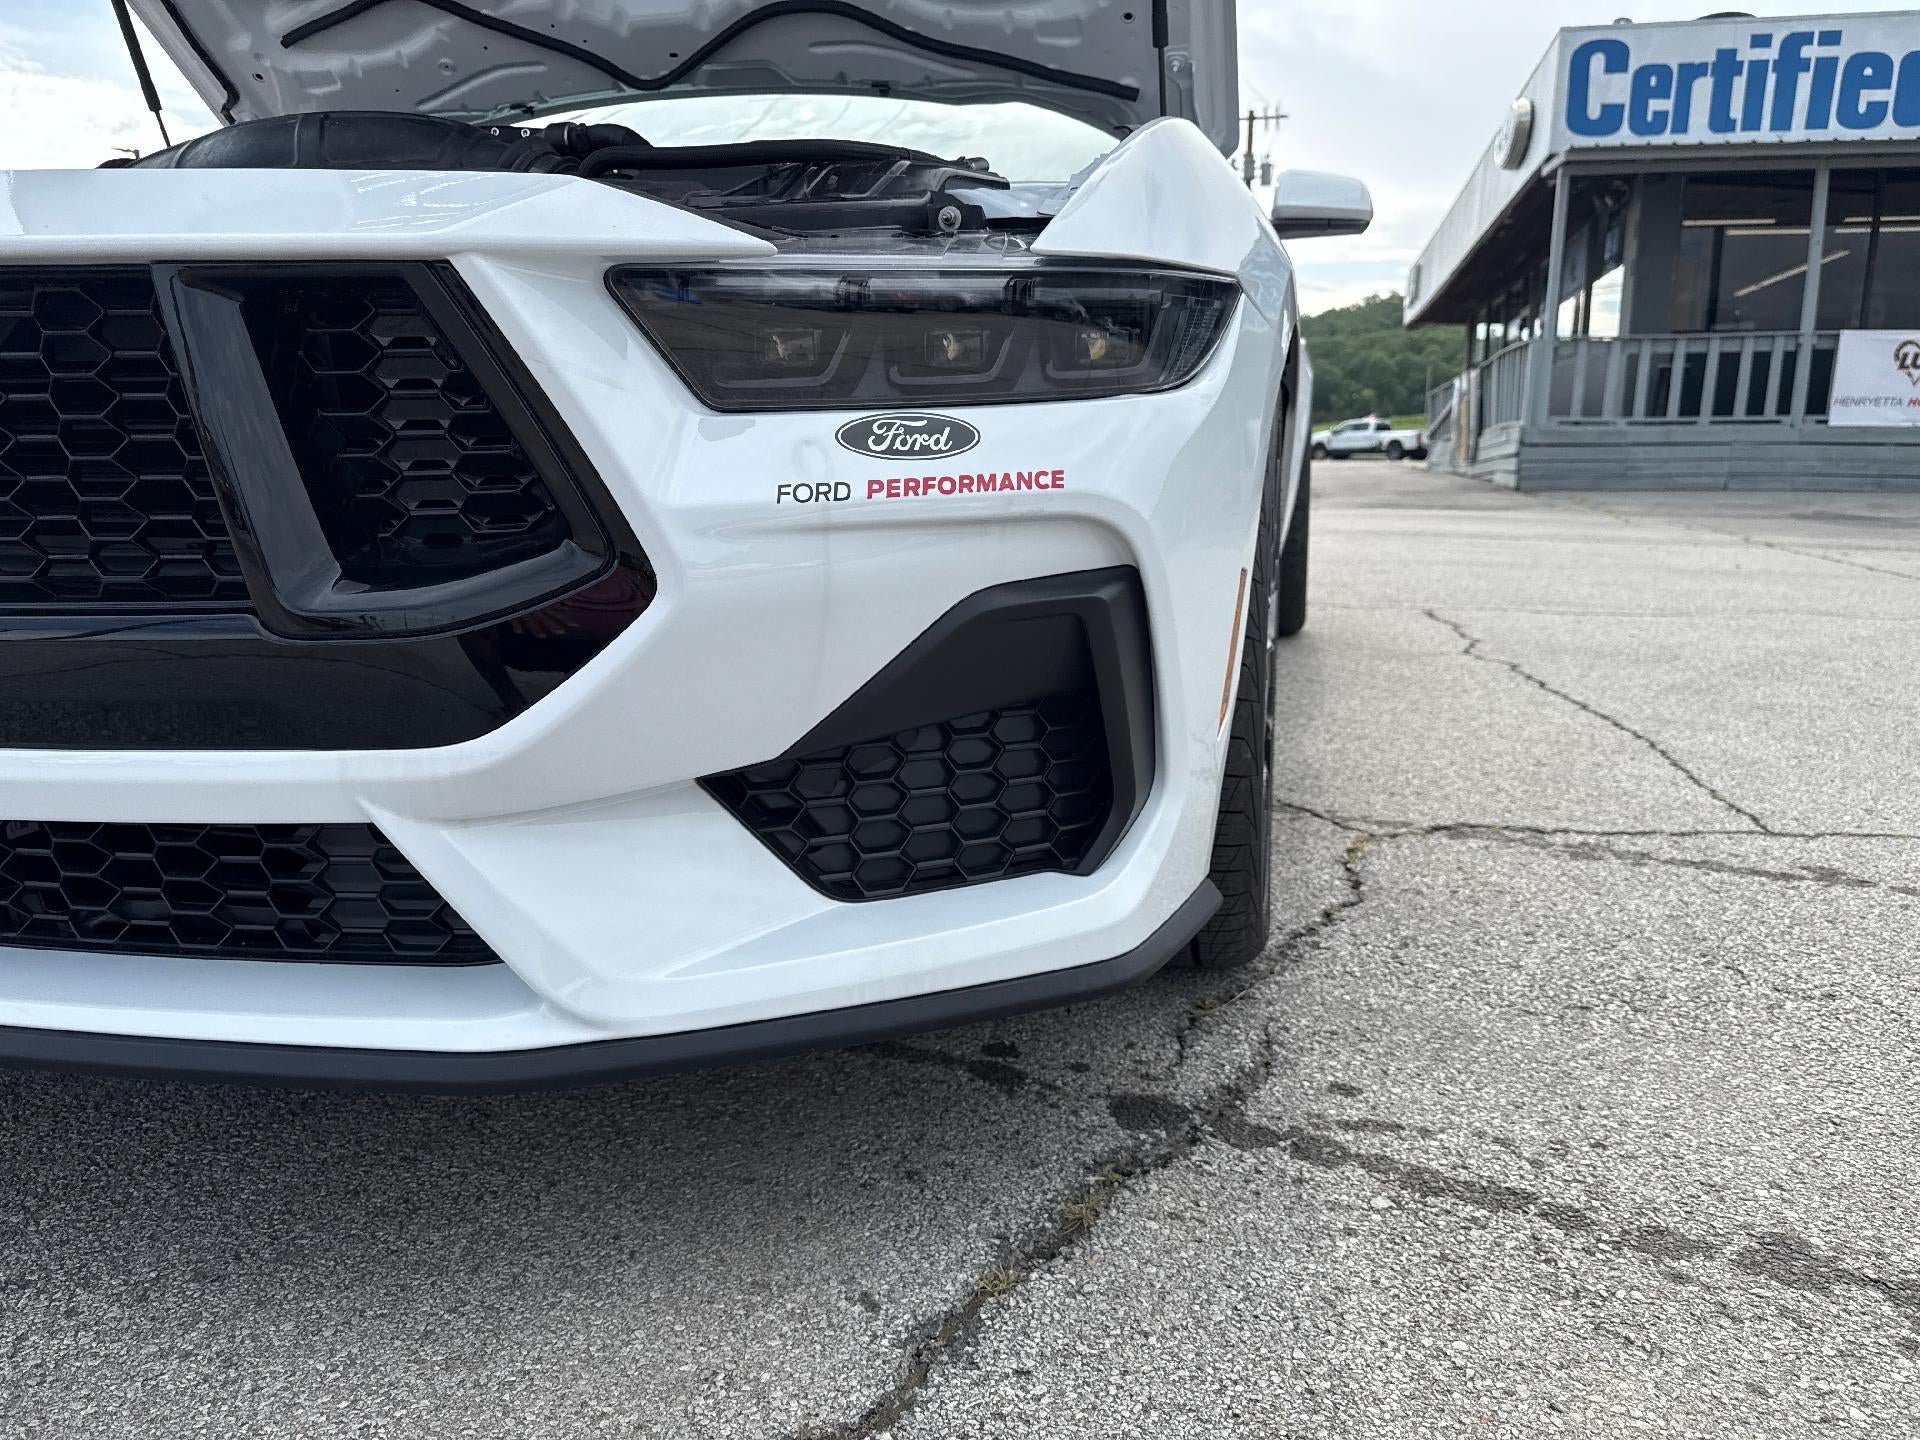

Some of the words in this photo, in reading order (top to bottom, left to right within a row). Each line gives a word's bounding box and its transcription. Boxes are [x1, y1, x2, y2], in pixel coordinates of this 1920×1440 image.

[1833, 396, 1902, 408] HENRYETTA
[867, 419, 953, 451] Ford
[776, 481, 851, 504] FORD
[866, 469, 1065, 499] PERFORMANCE
